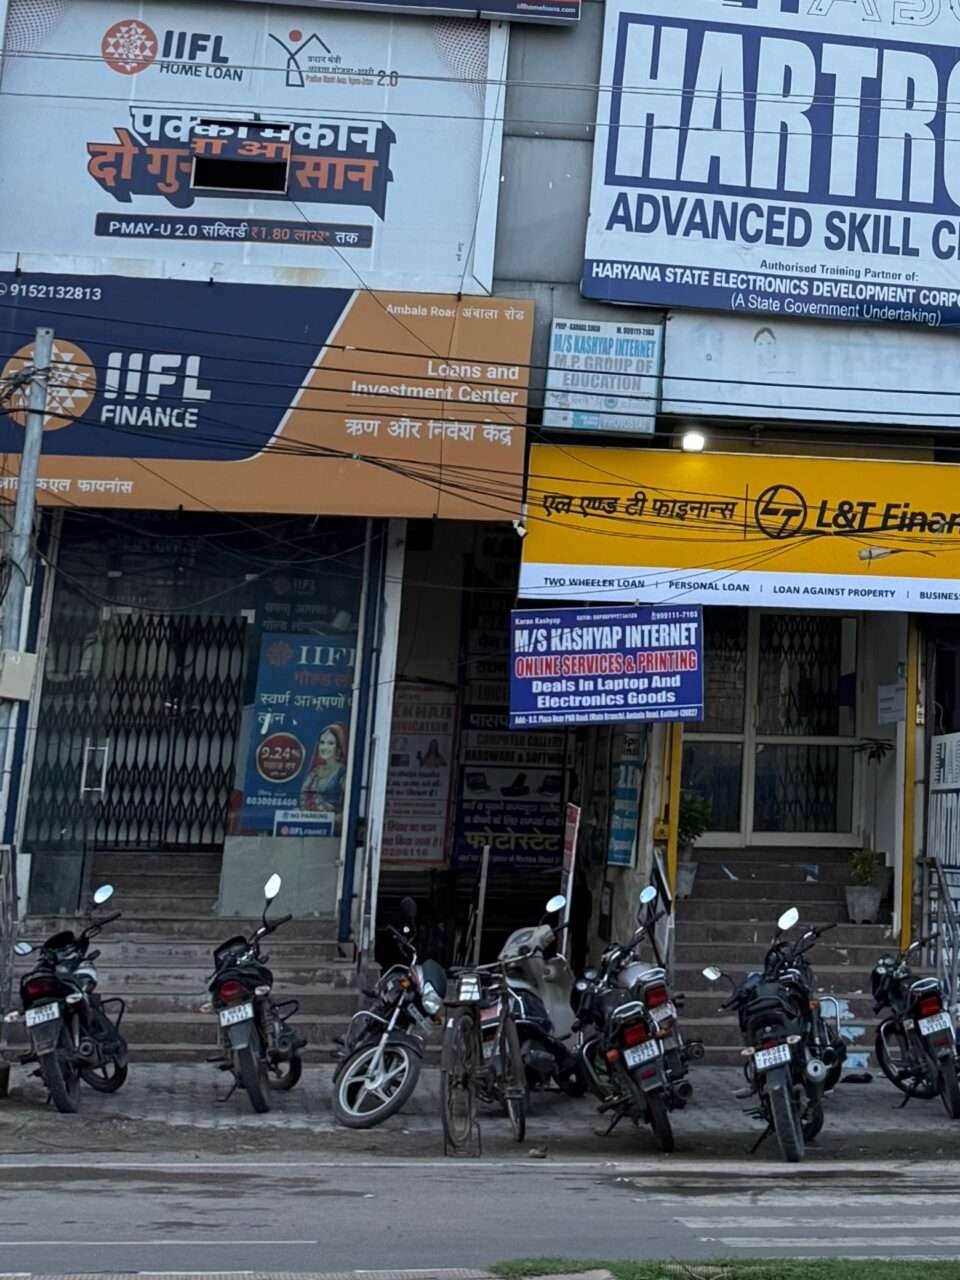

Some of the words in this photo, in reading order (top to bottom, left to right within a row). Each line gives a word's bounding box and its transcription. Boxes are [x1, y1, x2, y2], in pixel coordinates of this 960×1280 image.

[162, 29, 229, 65] IIFL
[205, 65, 244, 82] LOAN
[86, 127, 140, 187] दो
[109, 221, 171, 236] PMAY-U
[174, 224, 198, 238] 2.0
[334, 230, 360, 244] तक
[605, 192, 812, 248] ADVANCED
[823, 210, 920, 257] SKILL
[760, 259, 817, 274] Authorised
[820, 263, 861, 278] Training
[863, 268, 902, 281] Partner
[9, 282, 102, 301] 9152132813
[592, 261, 662, 283] HARYANA
[664, 267, 710, 286] STATE
[712, 271, 809, 296] ELECTRONICS
[812, 280, 917, 304] DEVELOPMENT
[747, 294, 780, 312] State
[784, 297, 860, 318] Government
[104, 351, 212, 402] IIFL
[427, 360, 481, 379] Loans
[486, 365, 520, 380] and
[100, 404, 199, 429] FINANCE
[624, 490, 648, 517] टी
[815, 499, 877, 531] L&T
[543, 576, 567, 588] TWO
[569, 578, 615, 589] WHEELER
[617, 579, 646, 590] LOAN
[668, 580, 720, 592] PERSONAL
[722, 582, 751, 593] LOAN
[773, 585, 800, 596] LOAN
[802, 586, 846, 598] AGAINST
[847, 588, 897, 600] PROPERTY
[550, 625, 623, 652] KASHYAP
[625, 622, 699, 649] INTERNET
[515, 655, 561, 679] ONLINE
[561, 652, 624, 677] SERVICES
[636, 649, 698, 673] PRINTING
[531, 679, 576, 694] Deals
[597, 676, 649, 691] Laptop
[651, 674, 681, 688] And
[536, 693, 625, 709] Electronics
[627, 690, 677, 705] Goods
